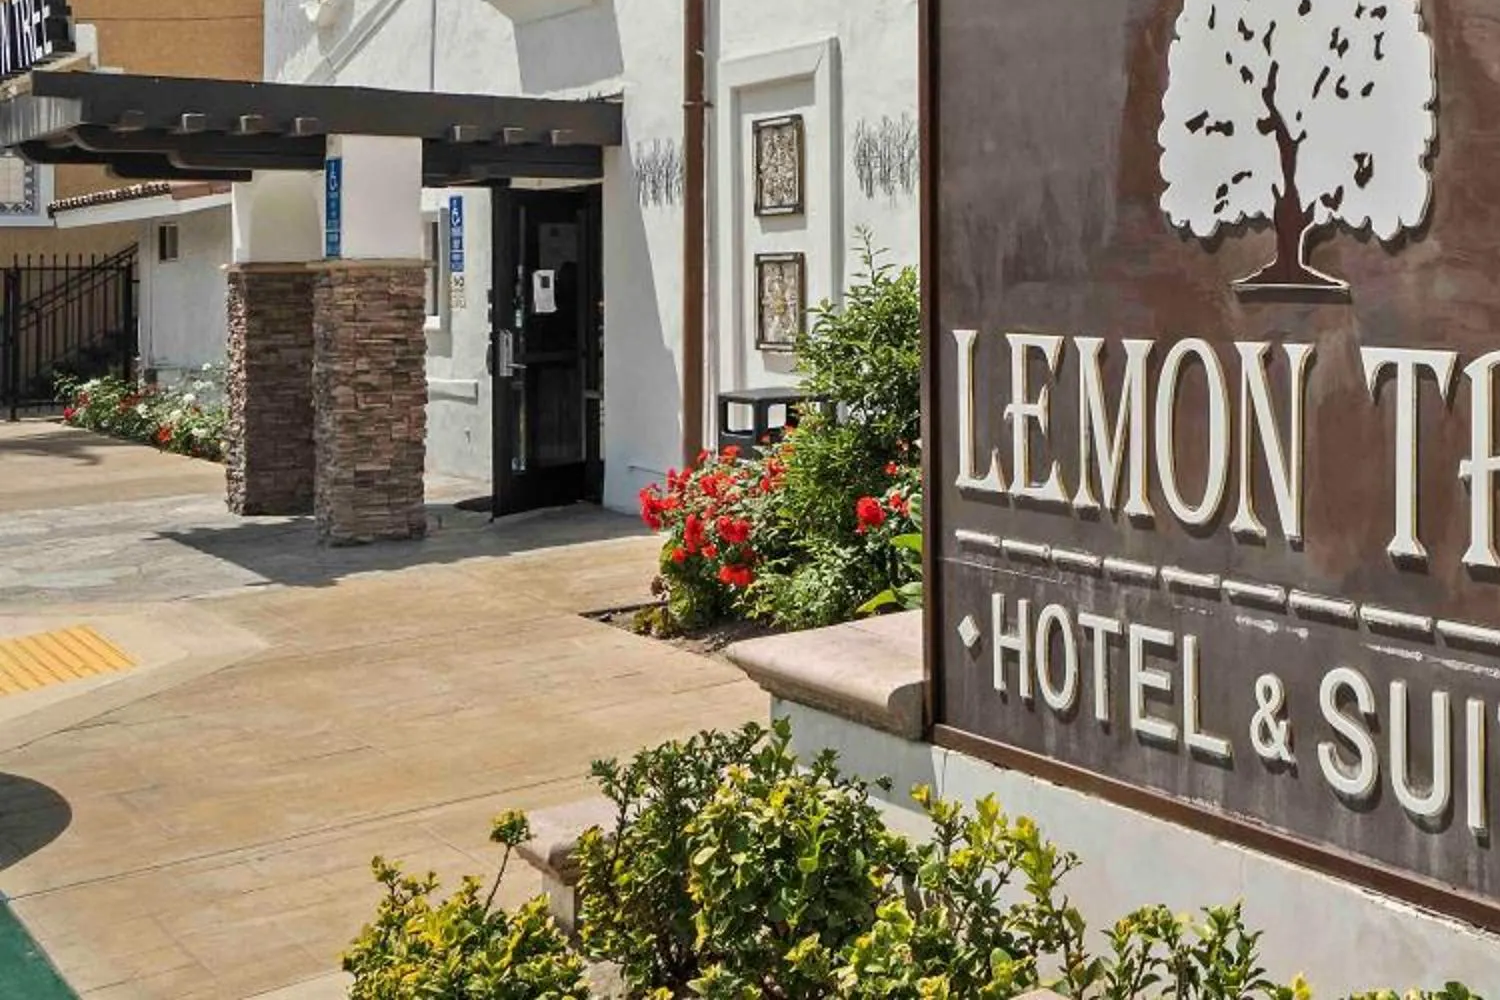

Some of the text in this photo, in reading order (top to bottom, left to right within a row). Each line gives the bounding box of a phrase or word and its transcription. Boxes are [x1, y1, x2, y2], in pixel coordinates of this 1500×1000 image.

[952, 329, 1315, 543] LEMON
[990, 592, 1232, 760] HOTEL
[1249, 673, 1295, 765] &
